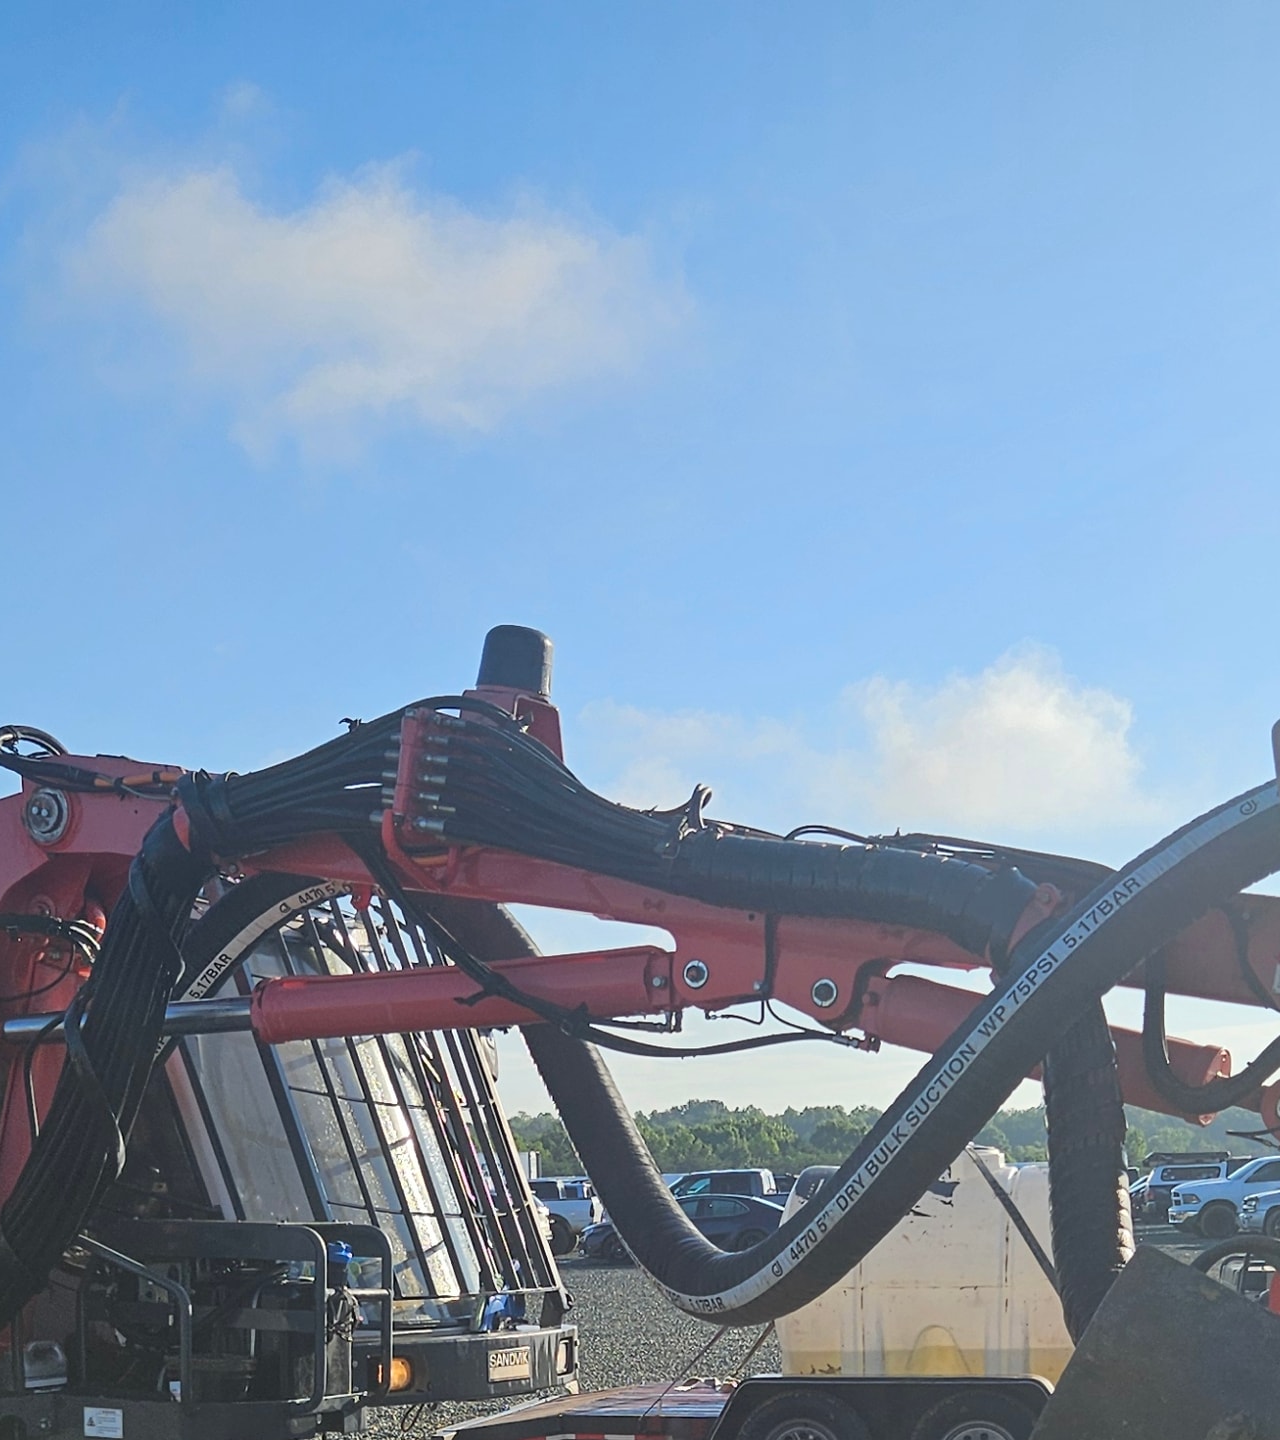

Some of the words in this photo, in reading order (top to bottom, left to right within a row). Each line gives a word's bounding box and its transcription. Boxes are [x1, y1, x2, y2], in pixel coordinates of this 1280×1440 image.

[189, 952, 232, 1000] 5.17BAR
[789, 1228, 818, 1261] 4470
[835, 1177, 866, 1212] DRY
[868, 1125, 908, 1179] BULK
[905, 1043, 977, 1127] SUCTION
[977, 1004, 1009, 1038] WP
[1006, 951, 1060, 1008] 75PSI
[1062, 876, 1141, 949] 5.17BAR
[490, 1351, 529, 1367] SANDVIK
